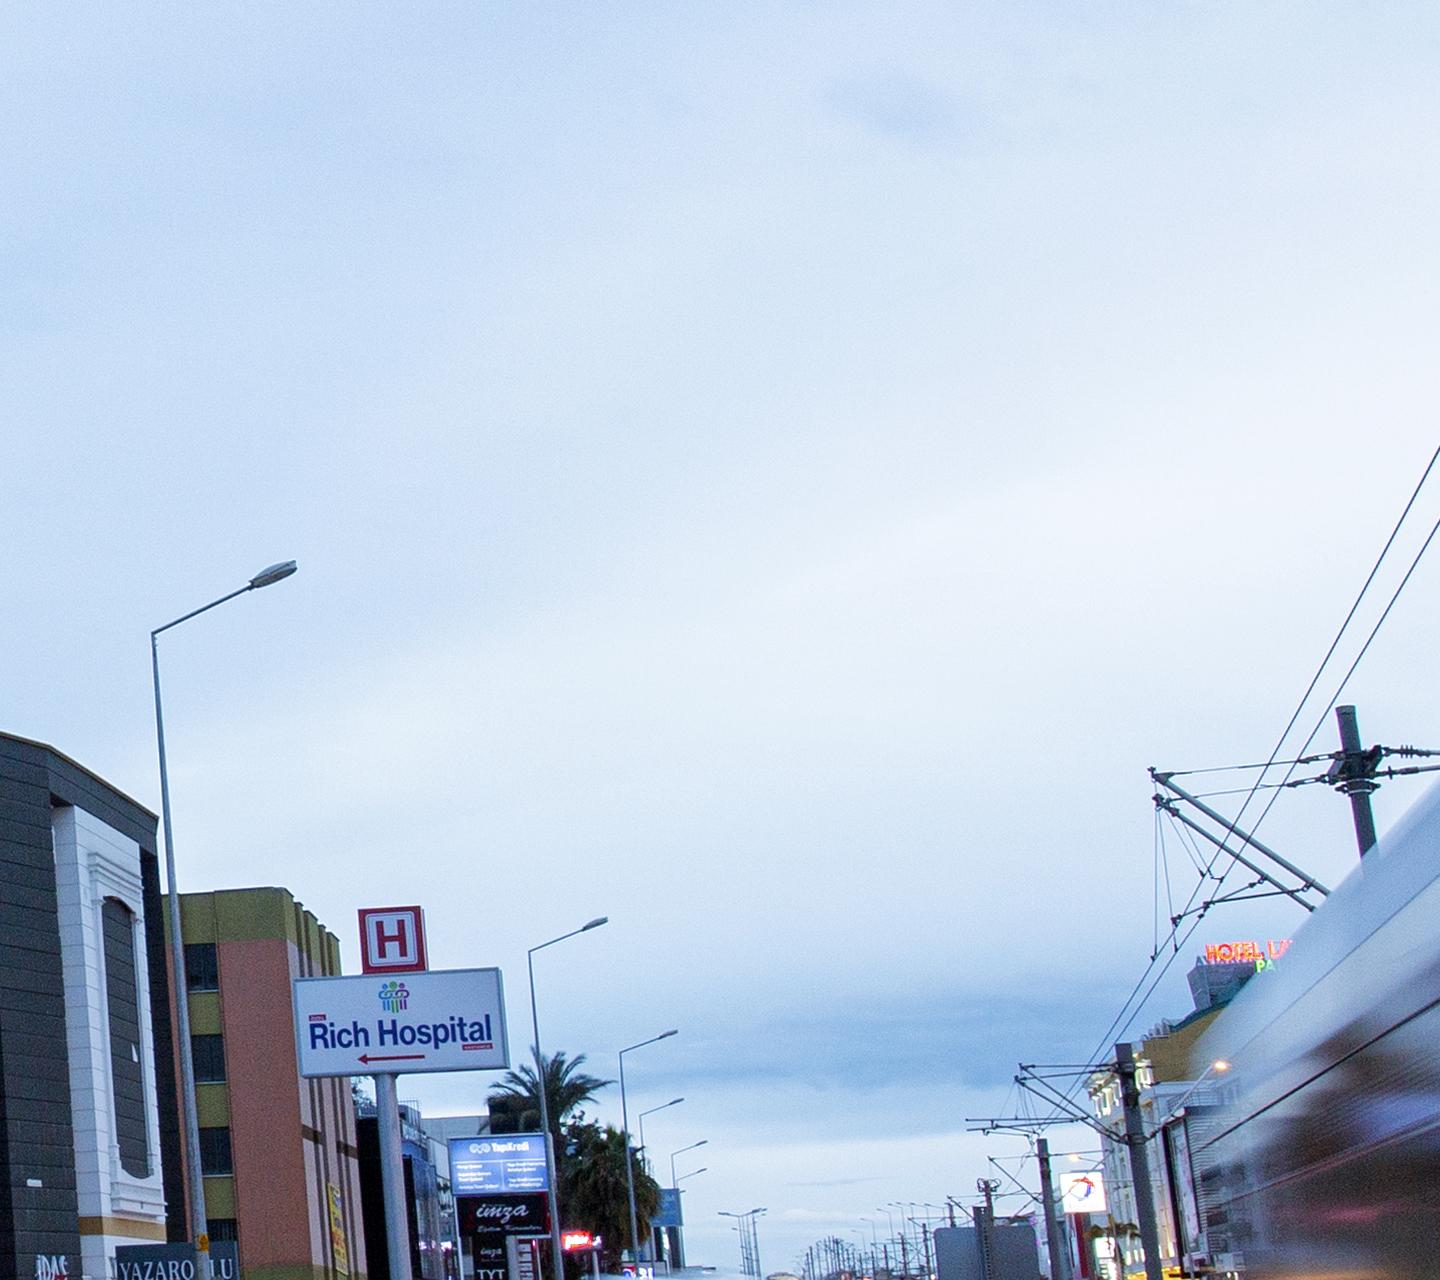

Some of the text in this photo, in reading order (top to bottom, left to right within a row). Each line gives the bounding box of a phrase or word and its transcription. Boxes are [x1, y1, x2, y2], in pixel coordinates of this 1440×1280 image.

[375, 919, 408, 959] H
[1205, 942, 1265, 962] HOTEL
[309, 1013, 493, 1050] Rich Hospital
[476, 1204, 529, 1224] imza
[477, 1269, 505, 1280] TYT
